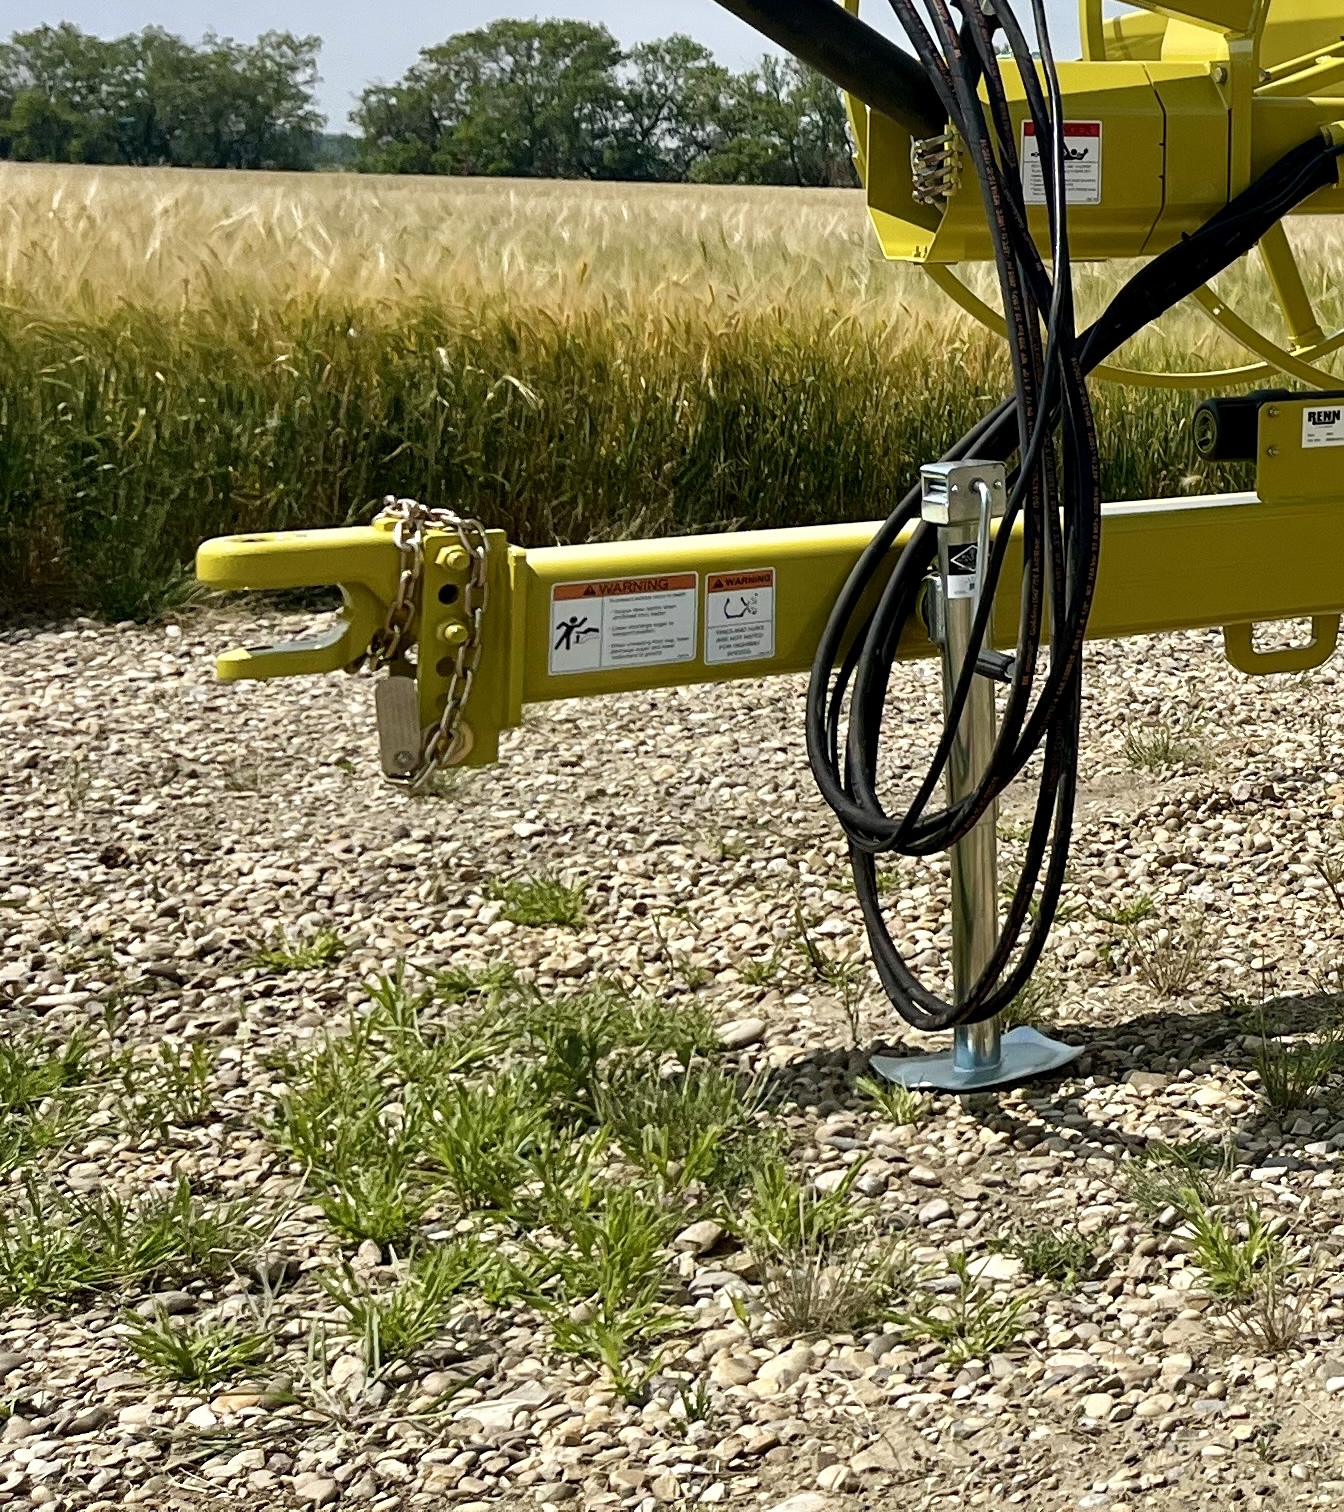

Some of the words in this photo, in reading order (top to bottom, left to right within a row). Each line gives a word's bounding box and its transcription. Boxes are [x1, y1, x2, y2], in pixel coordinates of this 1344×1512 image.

[1307, 409, 1341, 425] RENN
[599, 578, 670, 595] WARNING
[725, 574, 771, 587] WARNING
